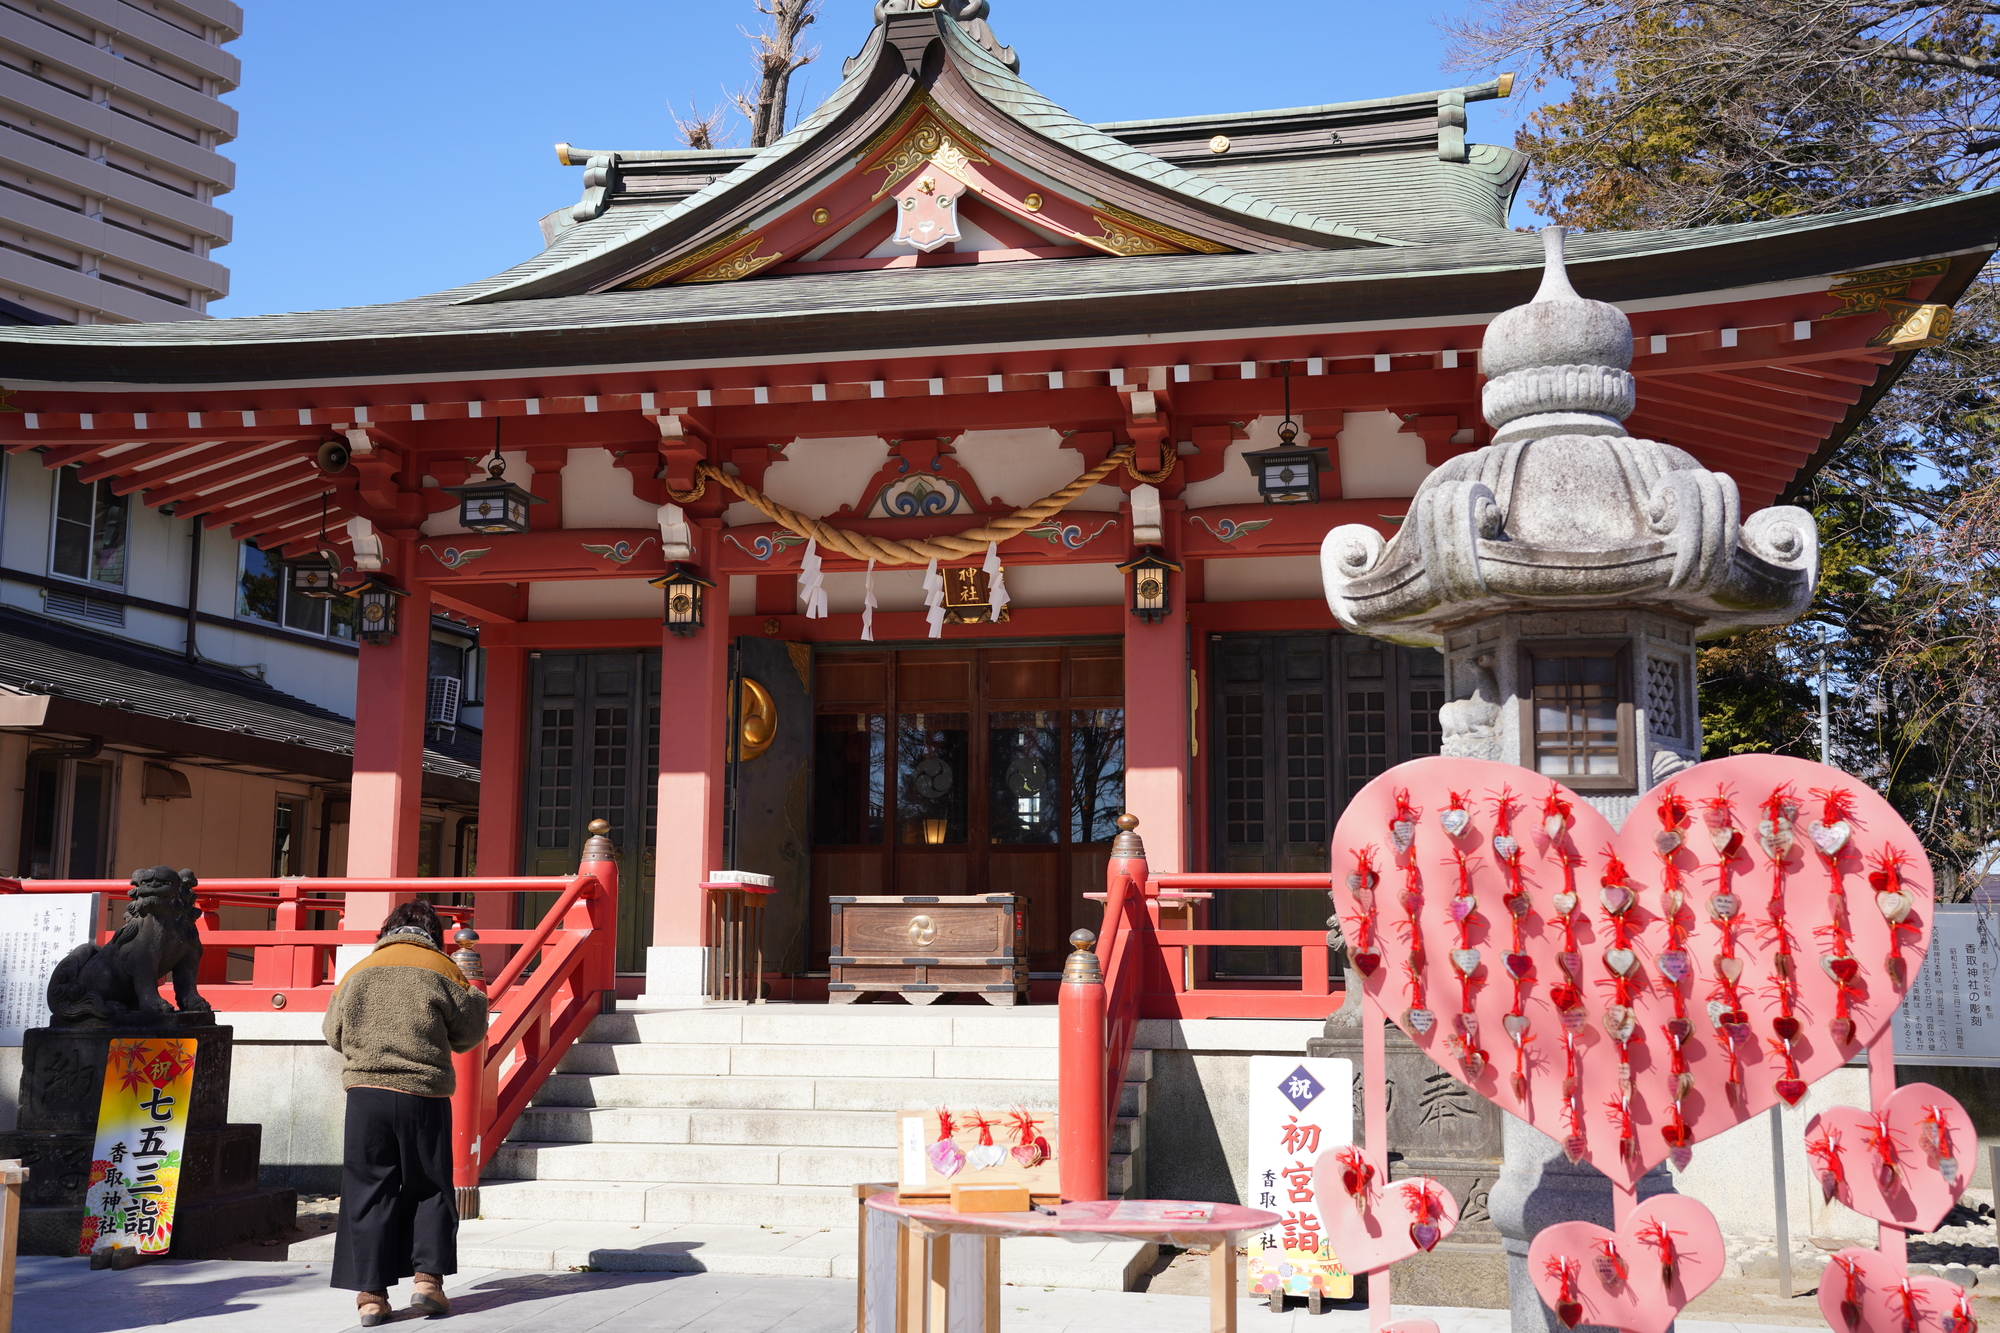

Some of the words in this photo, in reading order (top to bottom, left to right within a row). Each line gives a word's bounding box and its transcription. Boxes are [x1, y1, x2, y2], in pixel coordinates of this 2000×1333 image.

[959, 567, 979, 601] 神社
[1965, 944, 1982, 1026] 香取神社の彫刻
[1982, 962, 1992, 997] 有形文化財
[1985, 1005, 1993, 1019] 彫刻
[150, 1058, 173, 1081] 祝
[1288, 1076, 1313, 1099] 祝
[1419, 1066, 1479, 1134] 奉
[97, 1141, 129, 1237] 香取神社
[124, 1088, 175, 1236] 七五三詣
[1280, 1115, 1322, 1254] 初宮詣
[1259, 1169, 1278, 1251] 香取社
